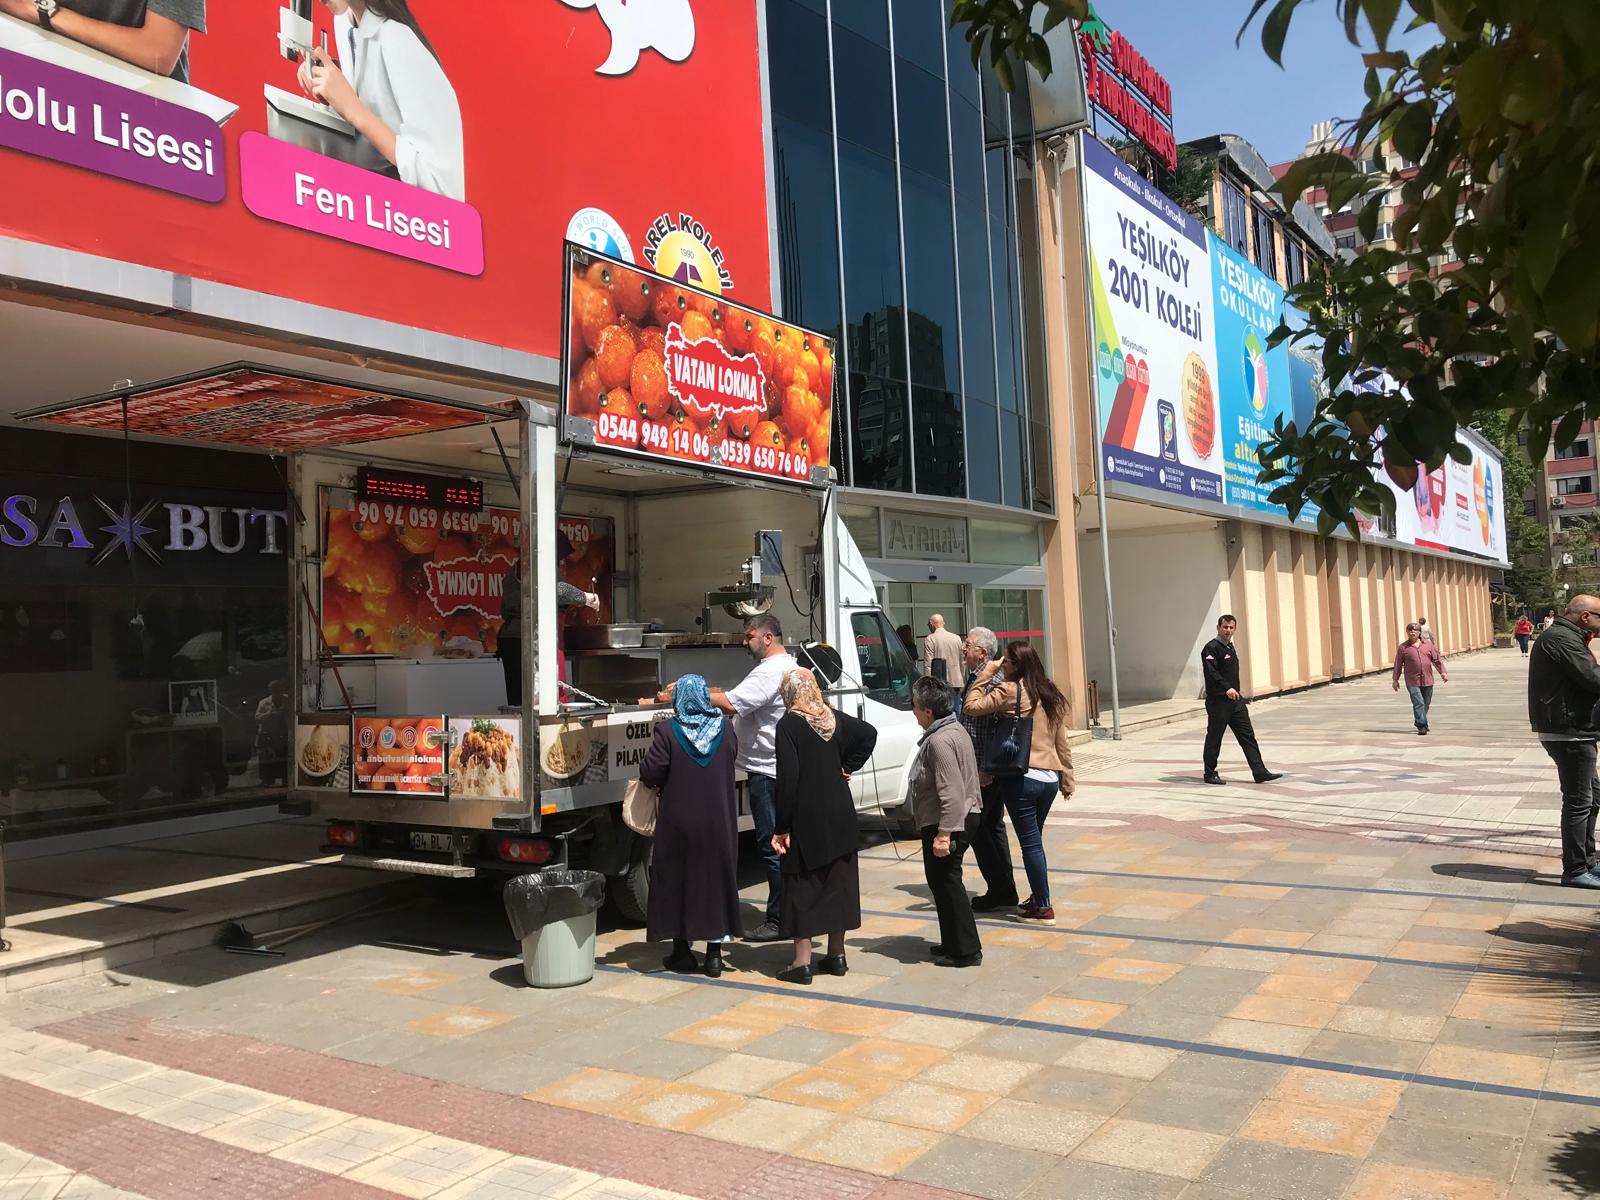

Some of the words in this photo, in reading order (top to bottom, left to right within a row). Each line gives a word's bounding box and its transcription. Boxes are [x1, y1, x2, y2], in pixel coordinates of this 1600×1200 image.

[0, 75, 77, 135] olu
[94, 104, 215, 176] Lisesi
[294, 173, 354, 220] Fen
[365, 191, 451, 249] Lisesi
[575, 215, 608, 231] WORLD
[643, 214, 677, 266] AREL
[680, 213, 734, 289] KOLEJİ
[680, 247, 695, 260] 1990
[1117, 211, 1190, 288] YEŞİLKÖY
[1217, 251, 1276, 316] YEŞİLKÖY
[1108, 258, 1149, 314] 2001
[1156, 286, 1202, 342] KOLEJİ
[674, 353, 715, 391] VATAN
[718, 371, 757, 401] LOKMA
[599, 412, 637, 443] 0544
[641, 421, 668, 449] 942
[673, 429, 689, 453] 14
[693, 432, 709, 457] 06
[721, 438, 751, 465] 0539
[753, 446, 775, 470] 650
[778, 451, 791, 473] 76
[794, 454, 807, 475] 06
[0, 494, 94, 548] SA
[359, 502, 380, 524] 06
[384, 504, 404, 525] 76
[409, 507, 438, 529] 650
[442, 510, 478, 533] 0539
[436, 570, 485, 597] LOKMA
[626, 720, 651, 740] ÖZEL
[616, 745, 646, 768] PİLAV
[415, 833, 427, 849] 34
